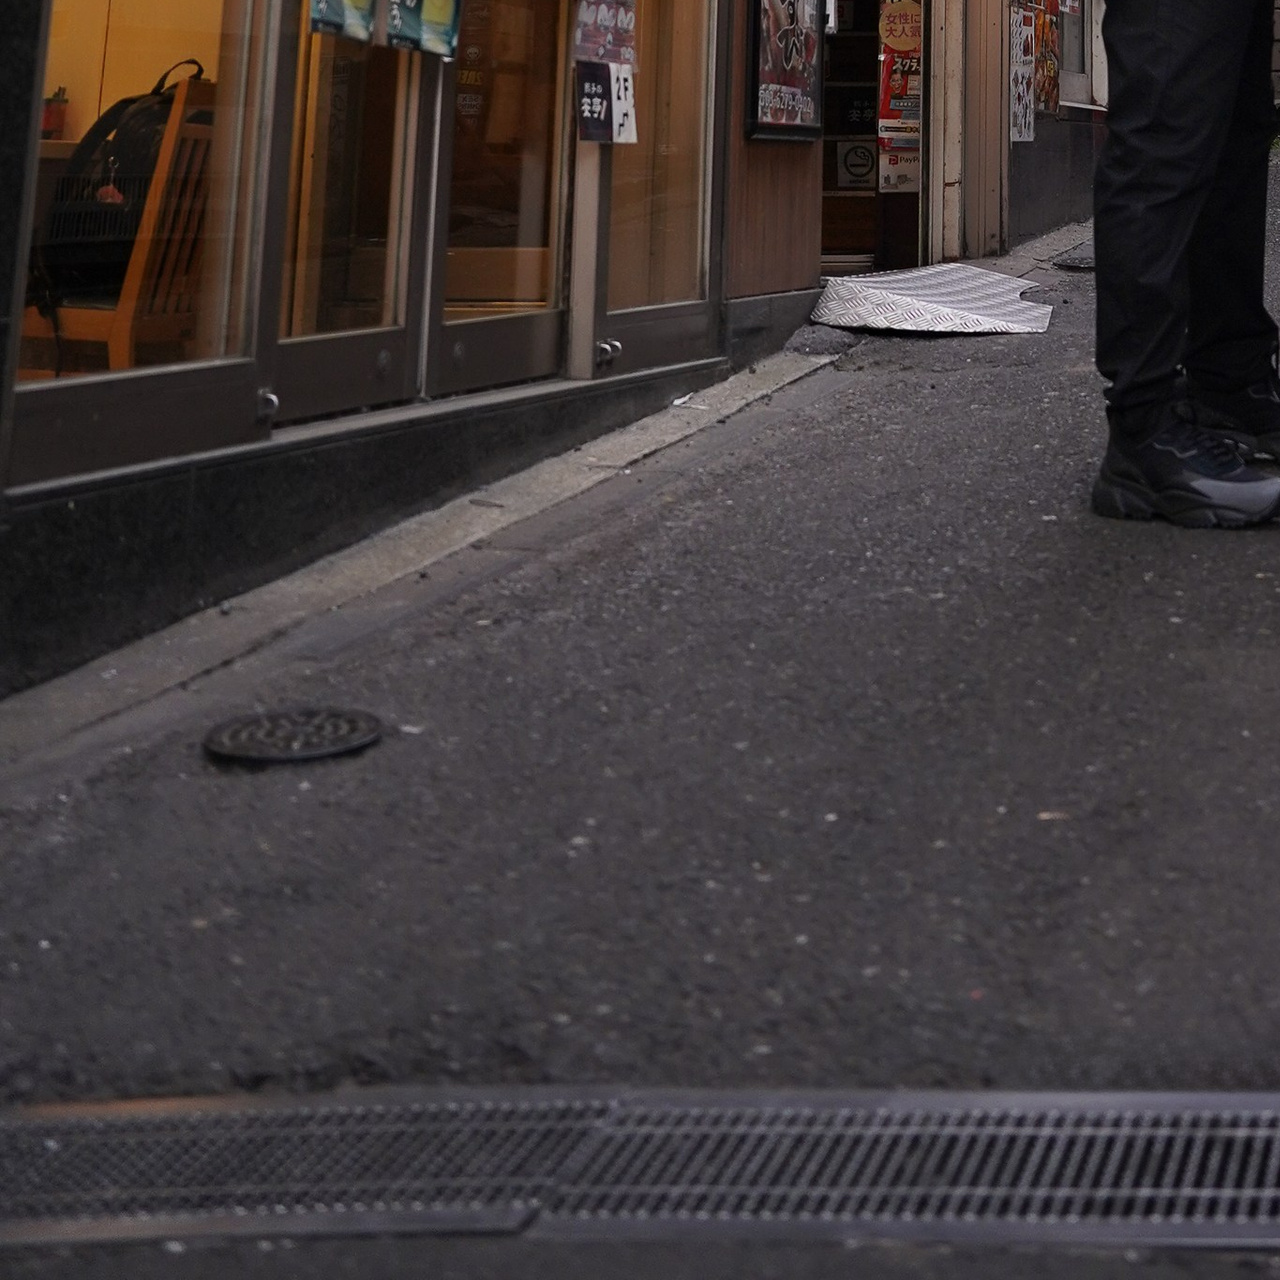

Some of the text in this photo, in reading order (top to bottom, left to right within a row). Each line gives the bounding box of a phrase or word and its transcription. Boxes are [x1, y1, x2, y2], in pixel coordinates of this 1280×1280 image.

[885, 13, 921, 27] 女性に
[885, 26, 921, 39] 大人気
[615, 75, 630, 102] 2F
